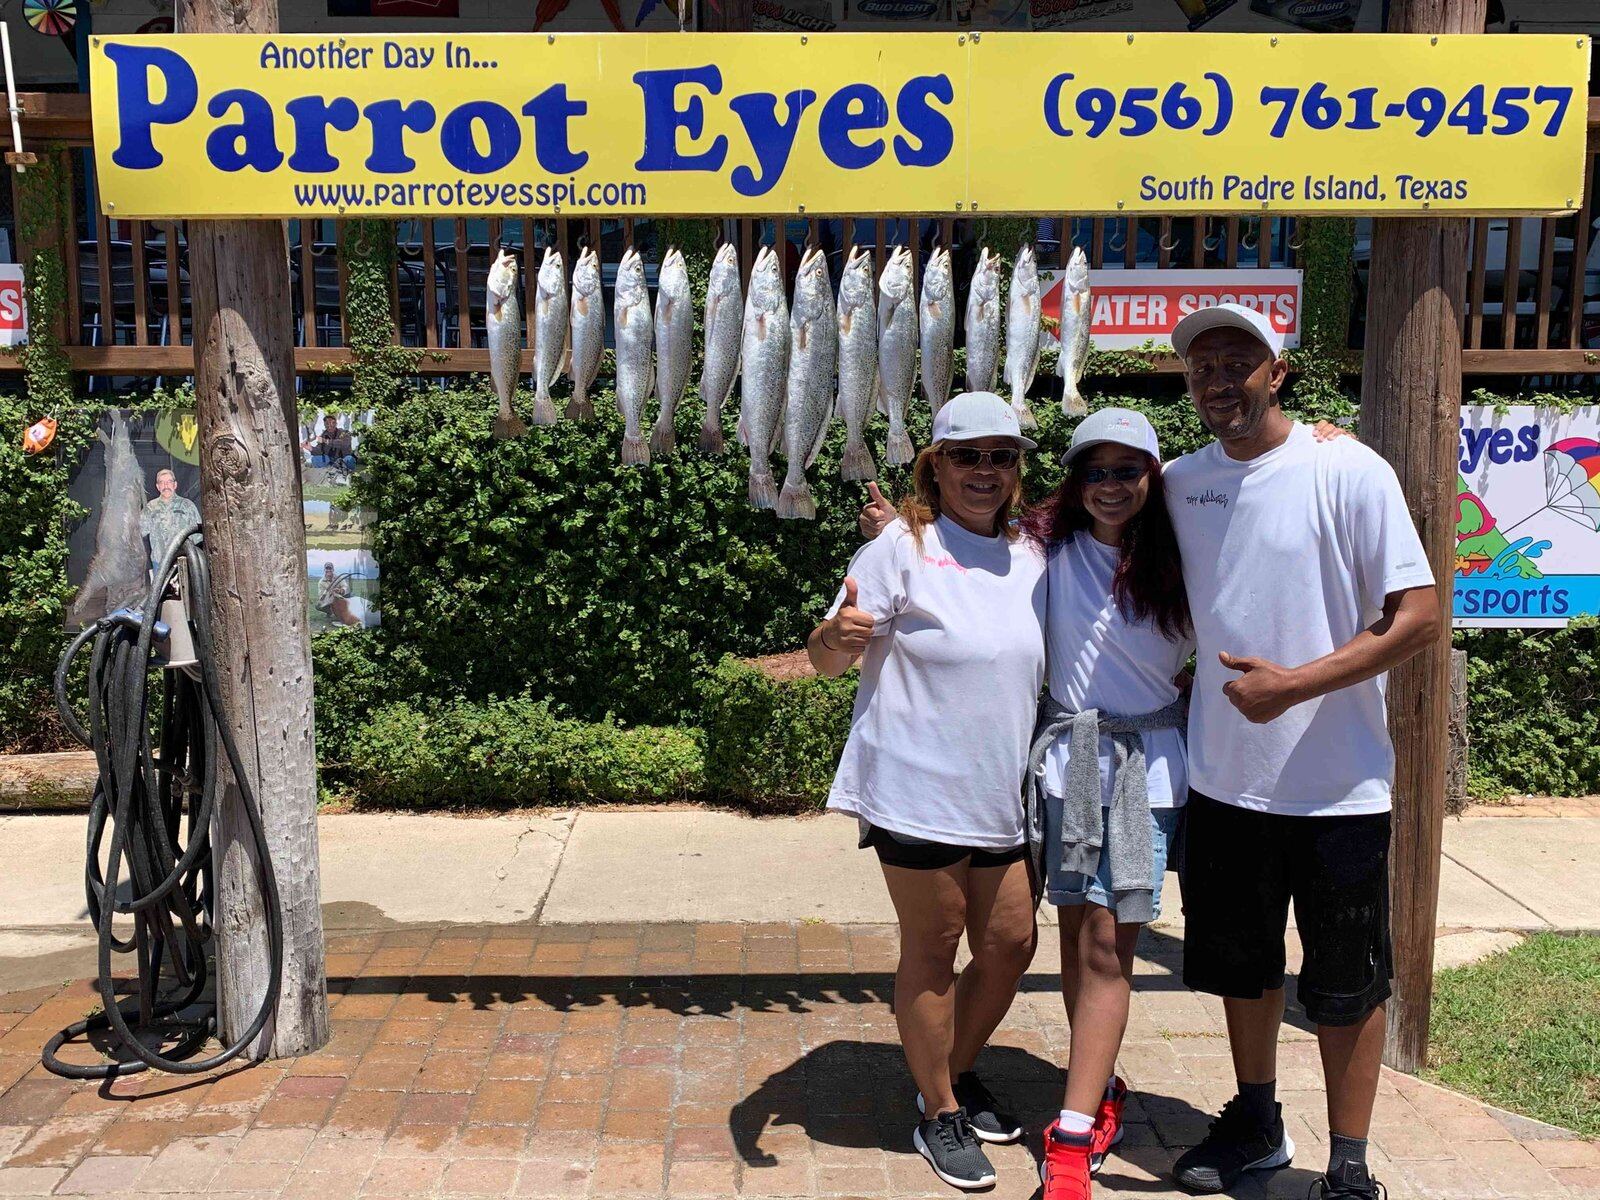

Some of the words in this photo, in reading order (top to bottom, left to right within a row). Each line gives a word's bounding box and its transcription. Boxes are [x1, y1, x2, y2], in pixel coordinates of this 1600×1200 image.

[865, 2, 892, 11] BUD
[894, 2, 931, 11] LIGHT
[1293, 5, 1316, 14] BUD
[1316, 1, 1344, 12] LIGHT
[261, 42, 372, 69] Another
[383, 41, 434, 69] Day
[445, 42, 498, 68] In...
[103, 42, 589, 174] Parrot
[632, 63, 954, 196] Eyes
[1043, 72, 1233, 137] (956)
[1260, 82, 1573, 138] 761-9457
[294, 178, 647, 206] www.parroteyesspi.com
[1140, 175, 1213, 200] South
[1223, 175, 1295, 200] Padre
[1304, 175, 1386, 202] Island,
[1397, 175, 1468, 200] Texas
[1089, 294, 1167, 326] ATER
[1177, 293, 1294, 326] SRTS
[1458, 416, 1540, 474] yes
